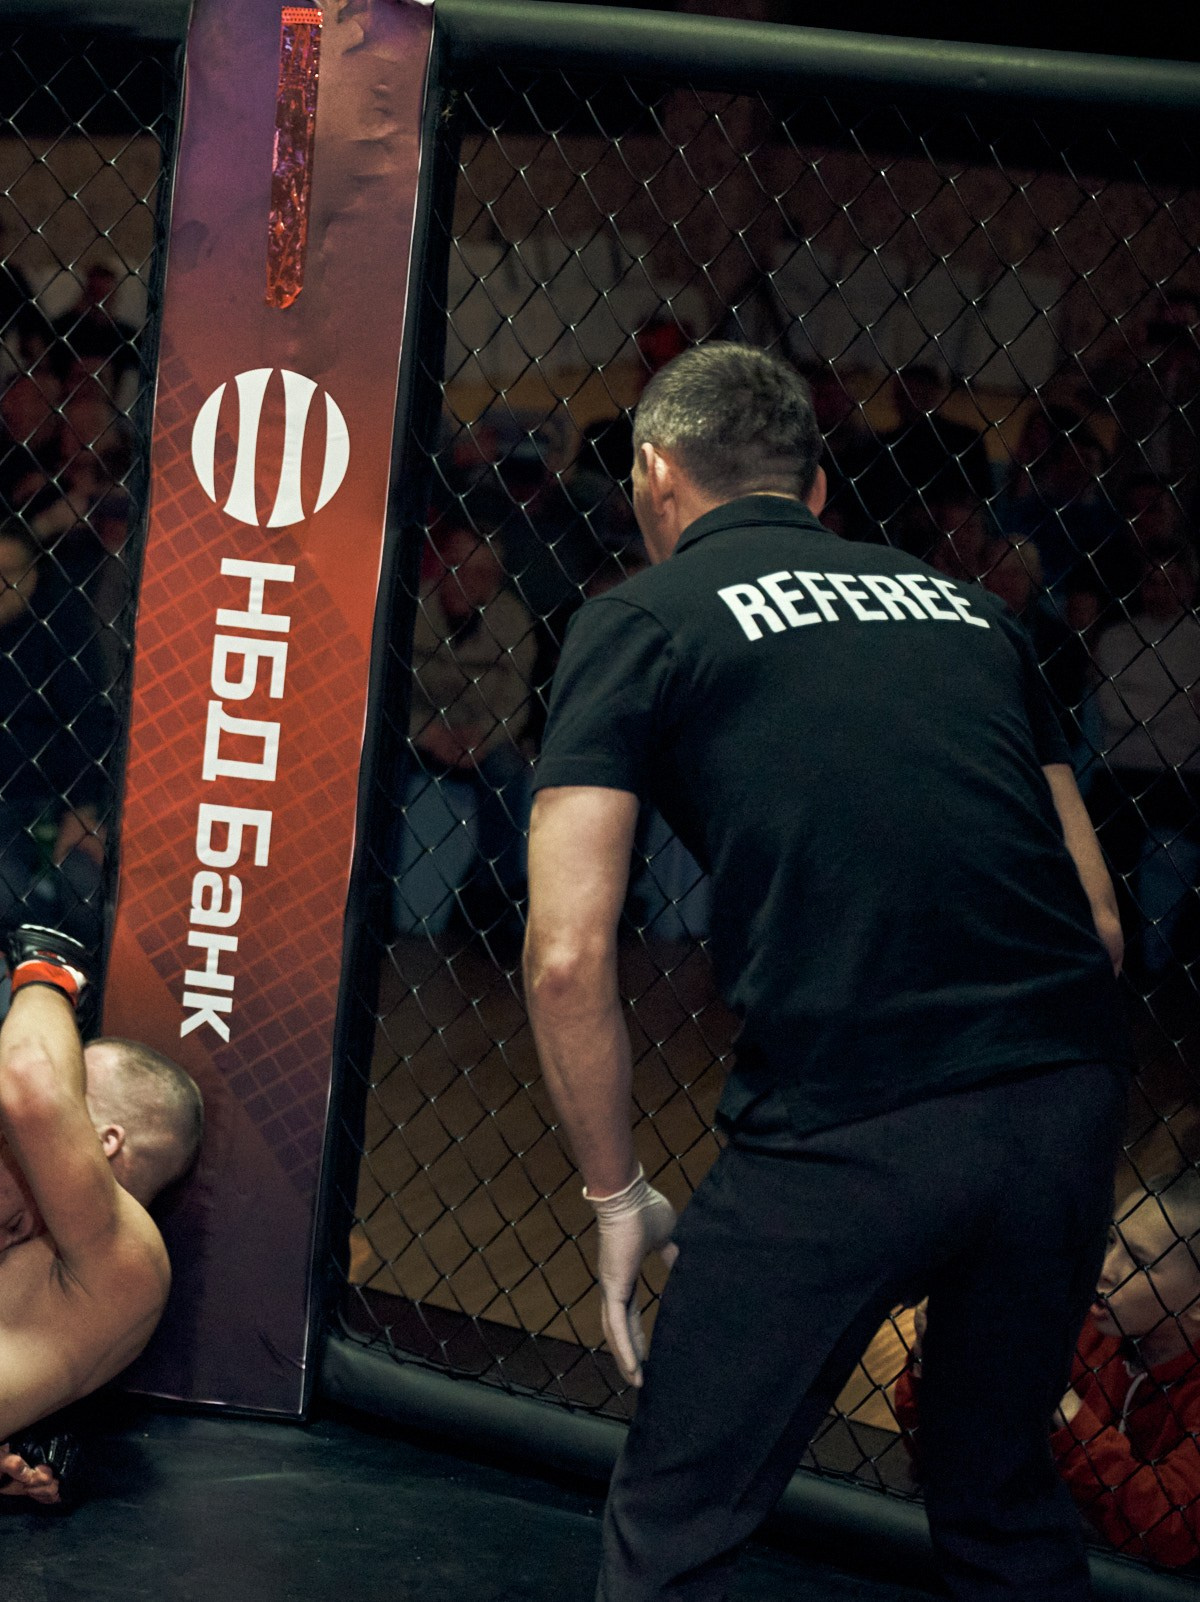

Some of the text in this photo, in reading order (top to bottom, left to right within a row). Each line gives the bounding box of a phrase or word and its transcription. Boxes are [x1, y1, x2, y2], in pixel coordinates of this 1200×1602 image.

[717, 570, 991, 641] REFEREE
[180, 557, 295, 1043] НБД Банк
